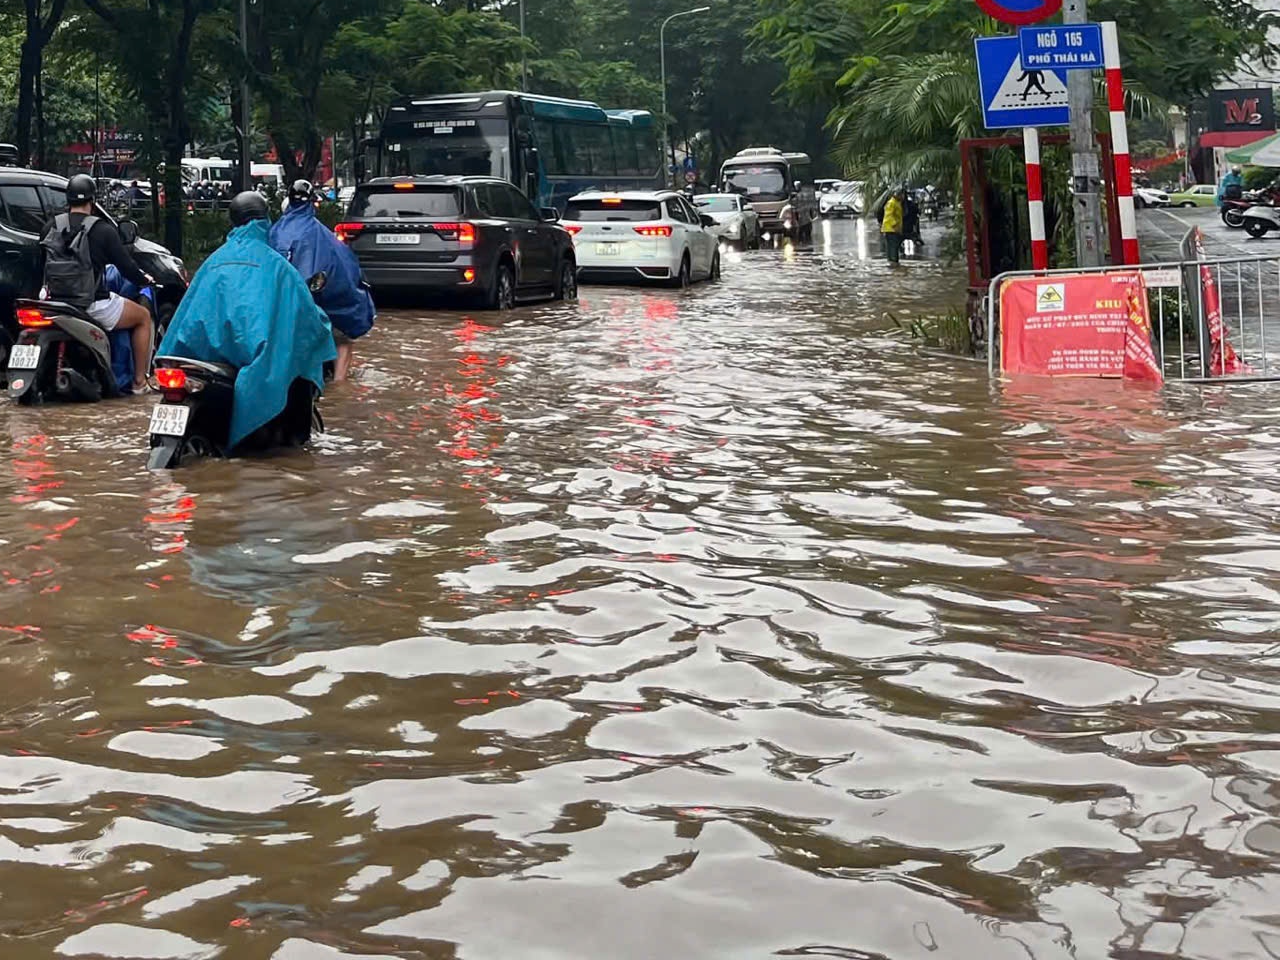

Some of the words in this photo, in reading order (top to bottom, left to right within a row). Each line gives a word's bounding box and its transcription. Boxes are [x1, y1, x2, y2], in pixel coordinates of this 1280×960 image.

[1036, 29, 1058, 48] NGÕ
[1064, 31, 1083, 47] 165
[1028, 51, 1051, 64] PHỐ
[1053, 51, 1078, 63] THÁI
[1081, 50, 1097, 62] HÀ
